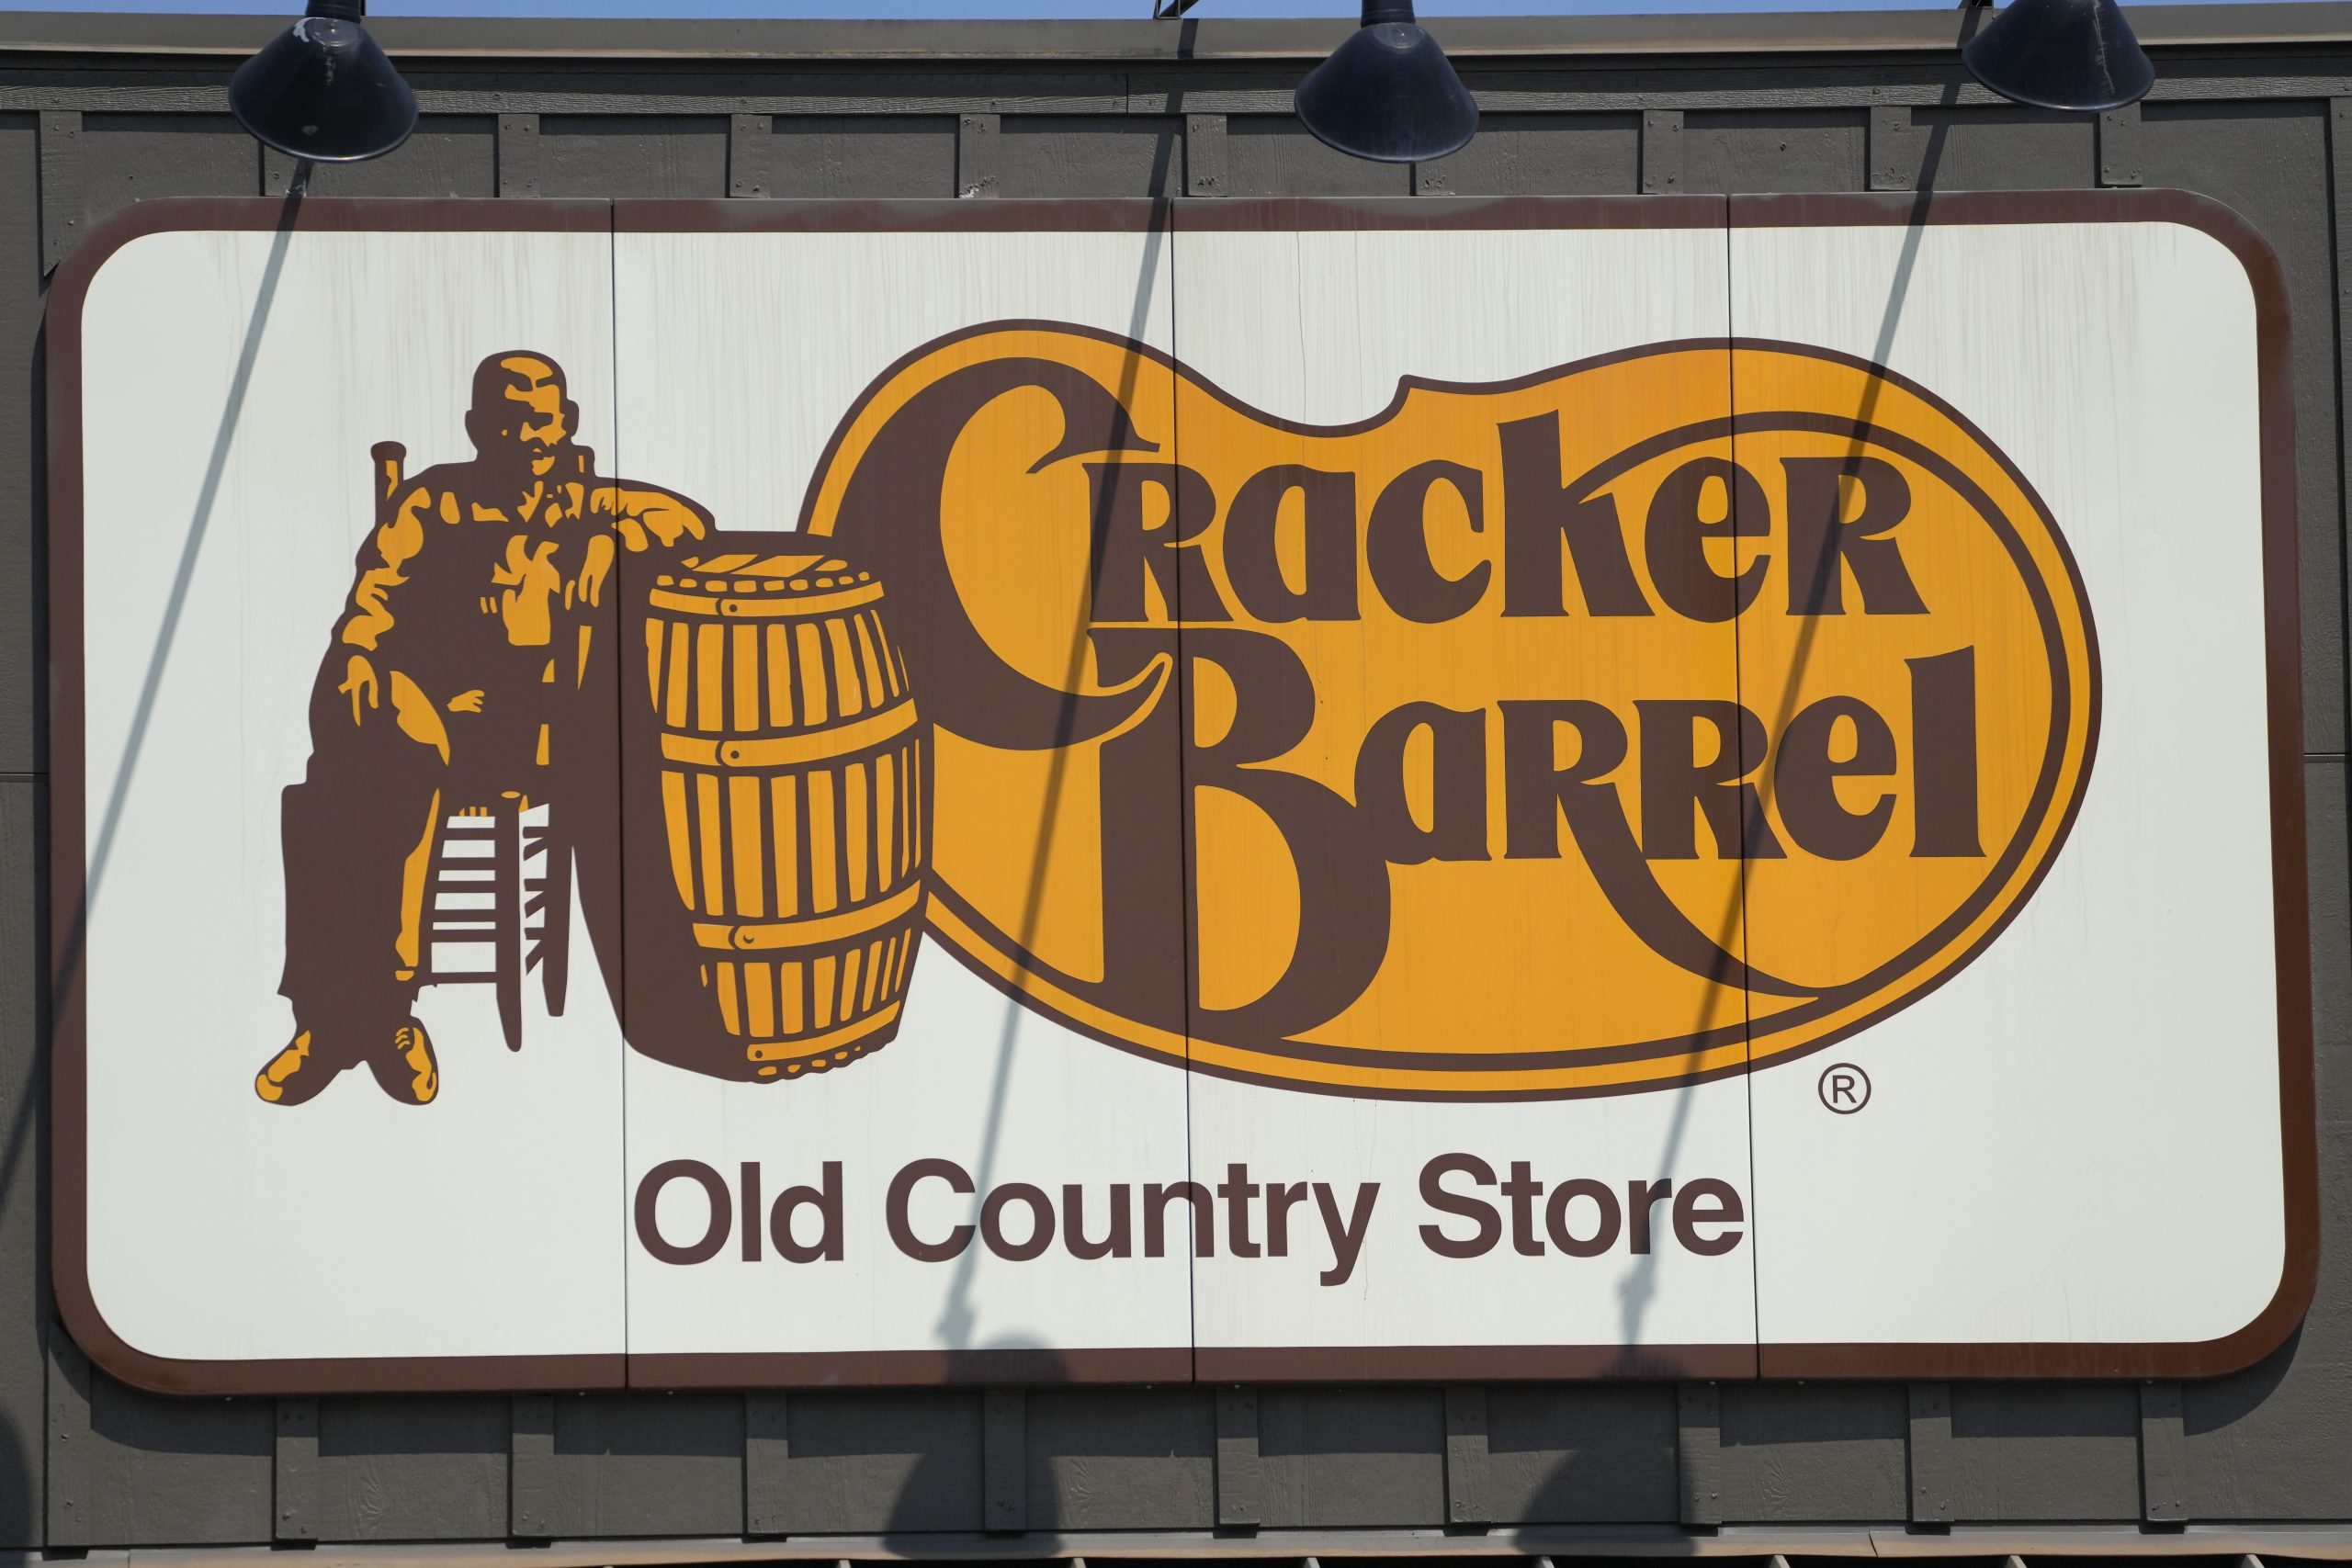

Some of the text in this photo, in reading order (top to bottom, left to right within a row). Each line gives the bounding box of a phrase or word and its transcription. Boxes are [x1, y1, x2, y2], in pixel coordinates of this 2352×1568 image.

[634, 1152, 1745, 1287] Old Country Store
